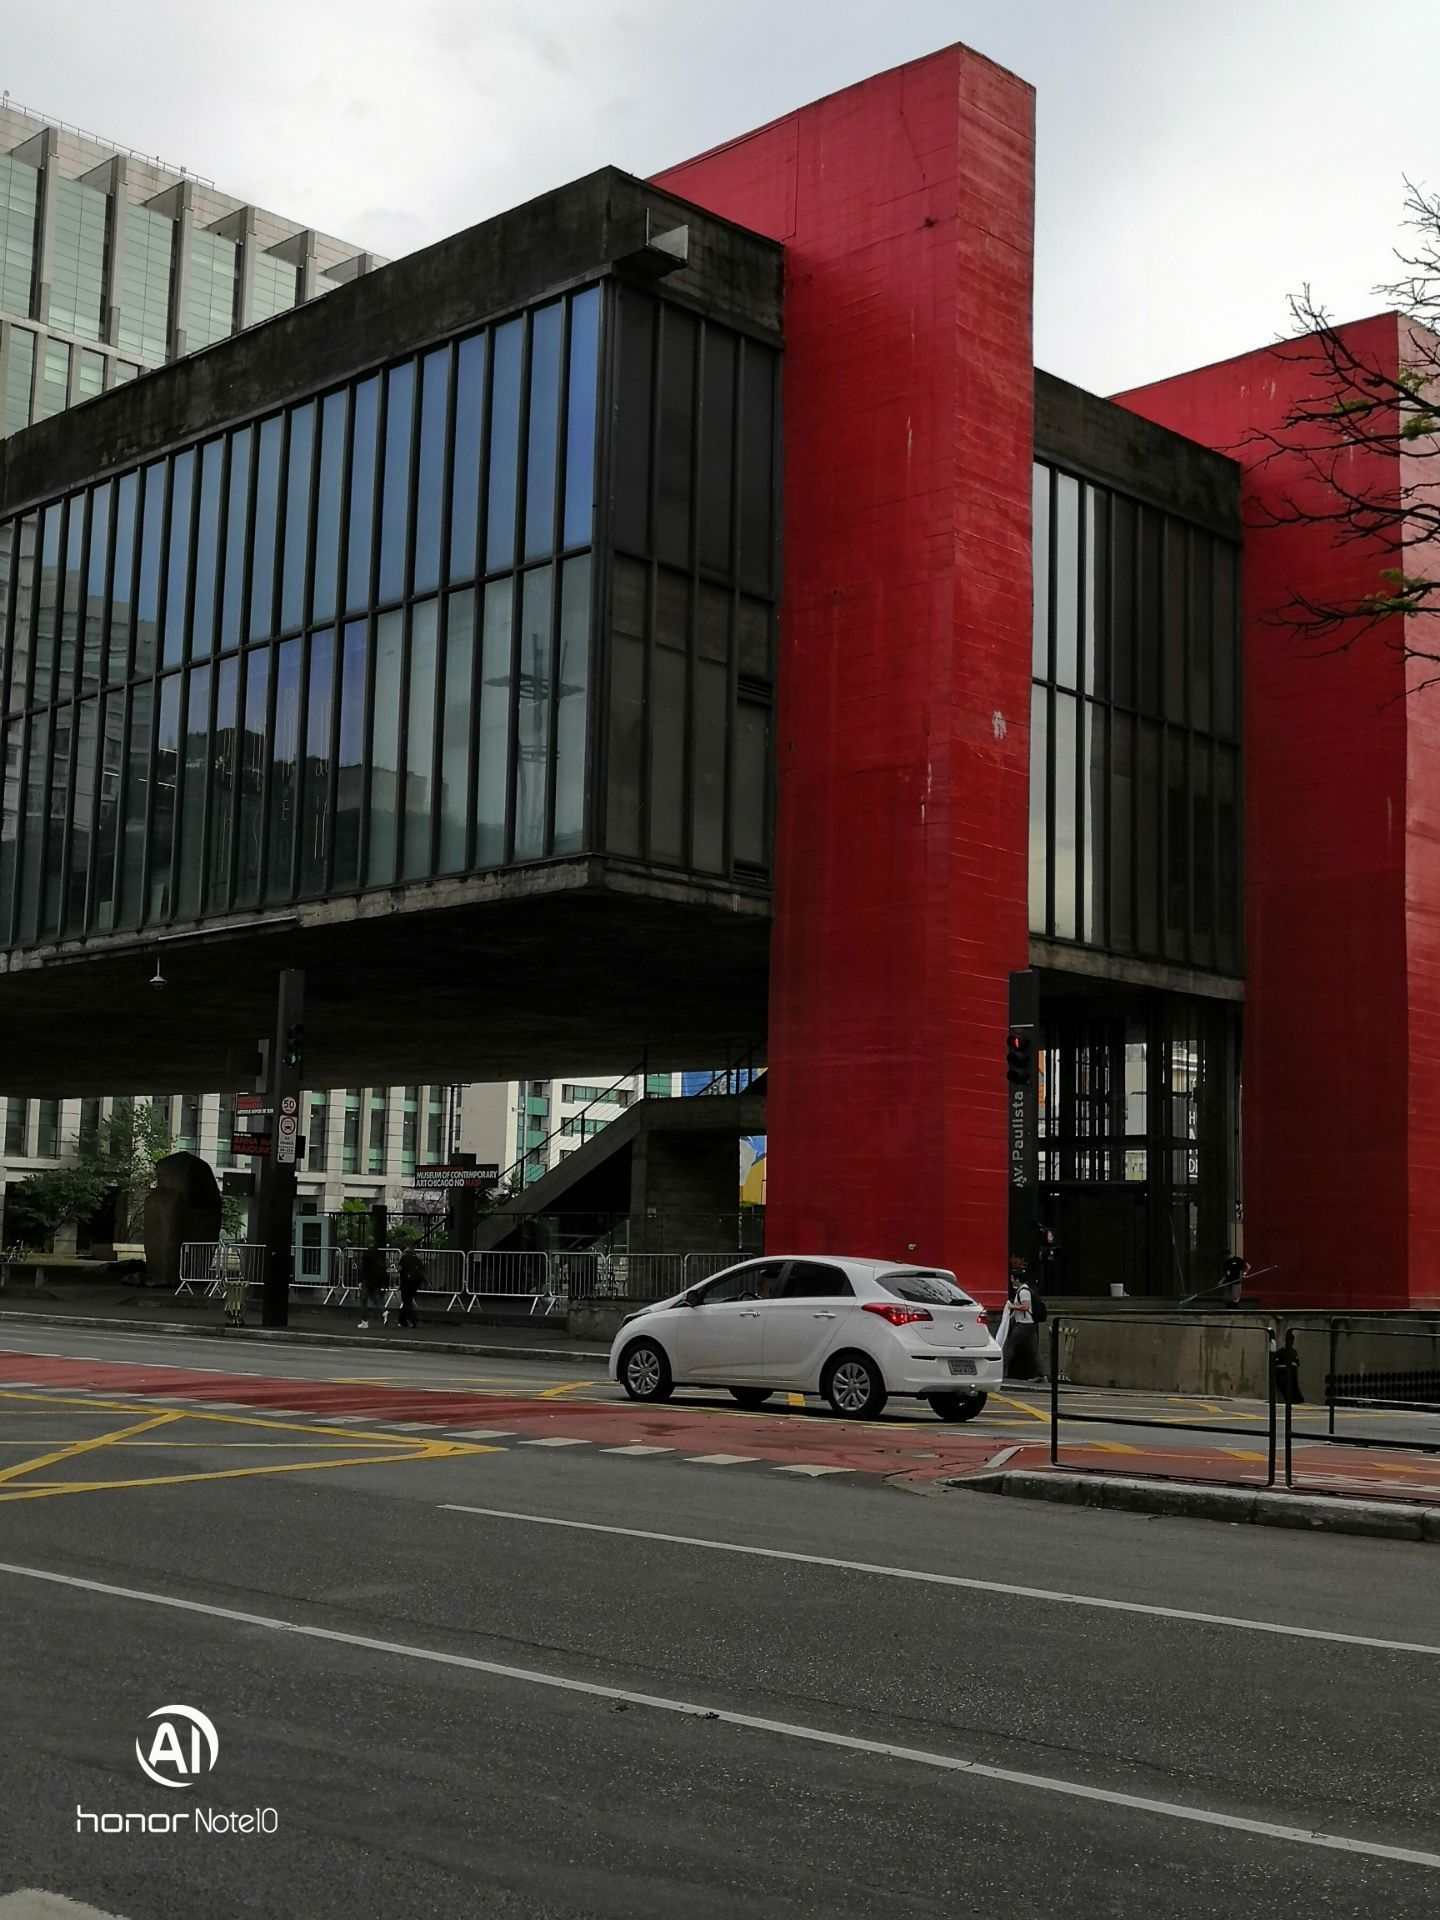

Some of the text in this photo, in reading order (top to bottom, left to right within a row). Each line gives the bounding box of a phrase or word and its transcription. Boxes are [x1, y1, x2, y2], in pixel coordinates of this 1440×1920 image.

[283, 1099, 295, 1109] 50
[1012, 1091, 1024, 1161] Paulista
[416, 1171, 498, 1179] MUSEUM OF CONTEMPORARY
[416, 1179, 427, 1187] ART
[427, 1179, 454, 1187] CHICAGO
[455, 1179, 464, 1187] NO
